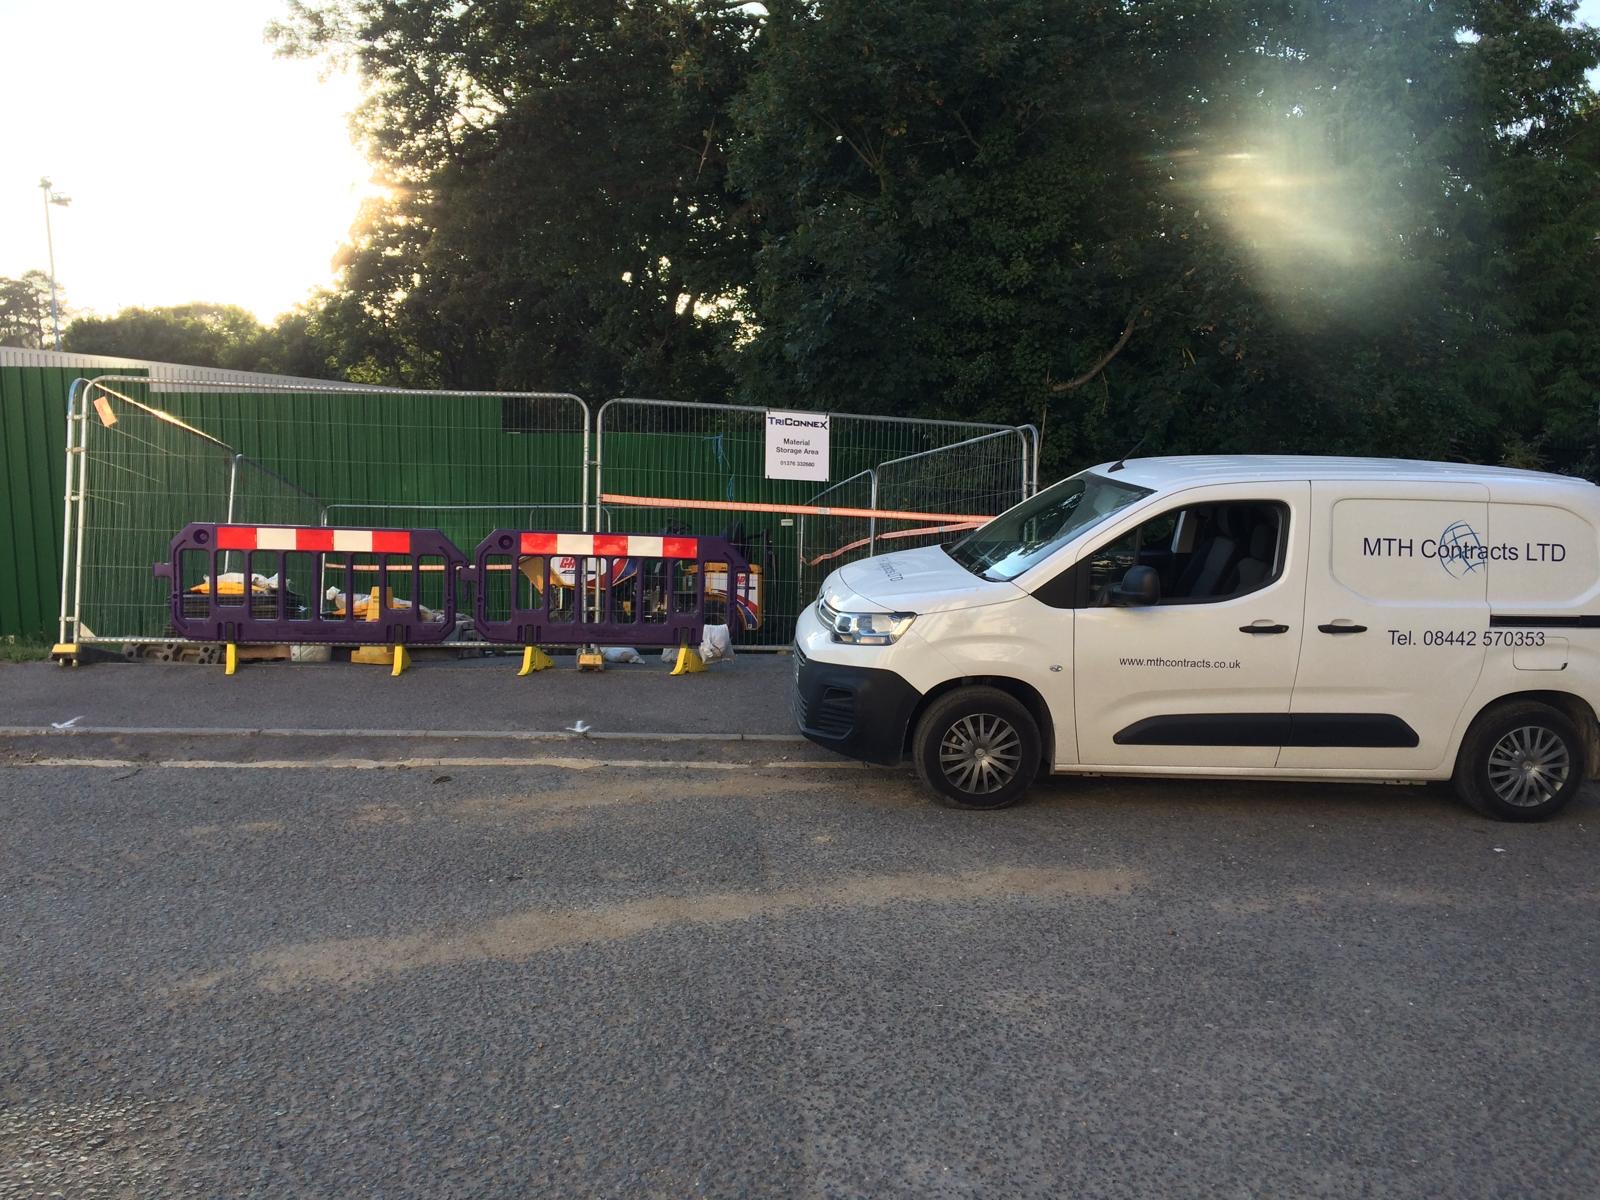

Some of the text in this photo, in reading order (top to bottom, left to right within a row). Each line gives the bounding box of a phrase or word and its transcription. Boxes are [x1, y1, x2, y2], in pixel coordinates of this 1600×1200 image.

[783, 438, 810, 446] Material
[776, 446, 802, 455] Storage
[1363, 537, 1567, 562] MTH Contracts LTD
[1388, 630, 1546, 648] Tel. 08442 570353
[1119, 657, 1241, 669] www.mthcontracts.co.uk
